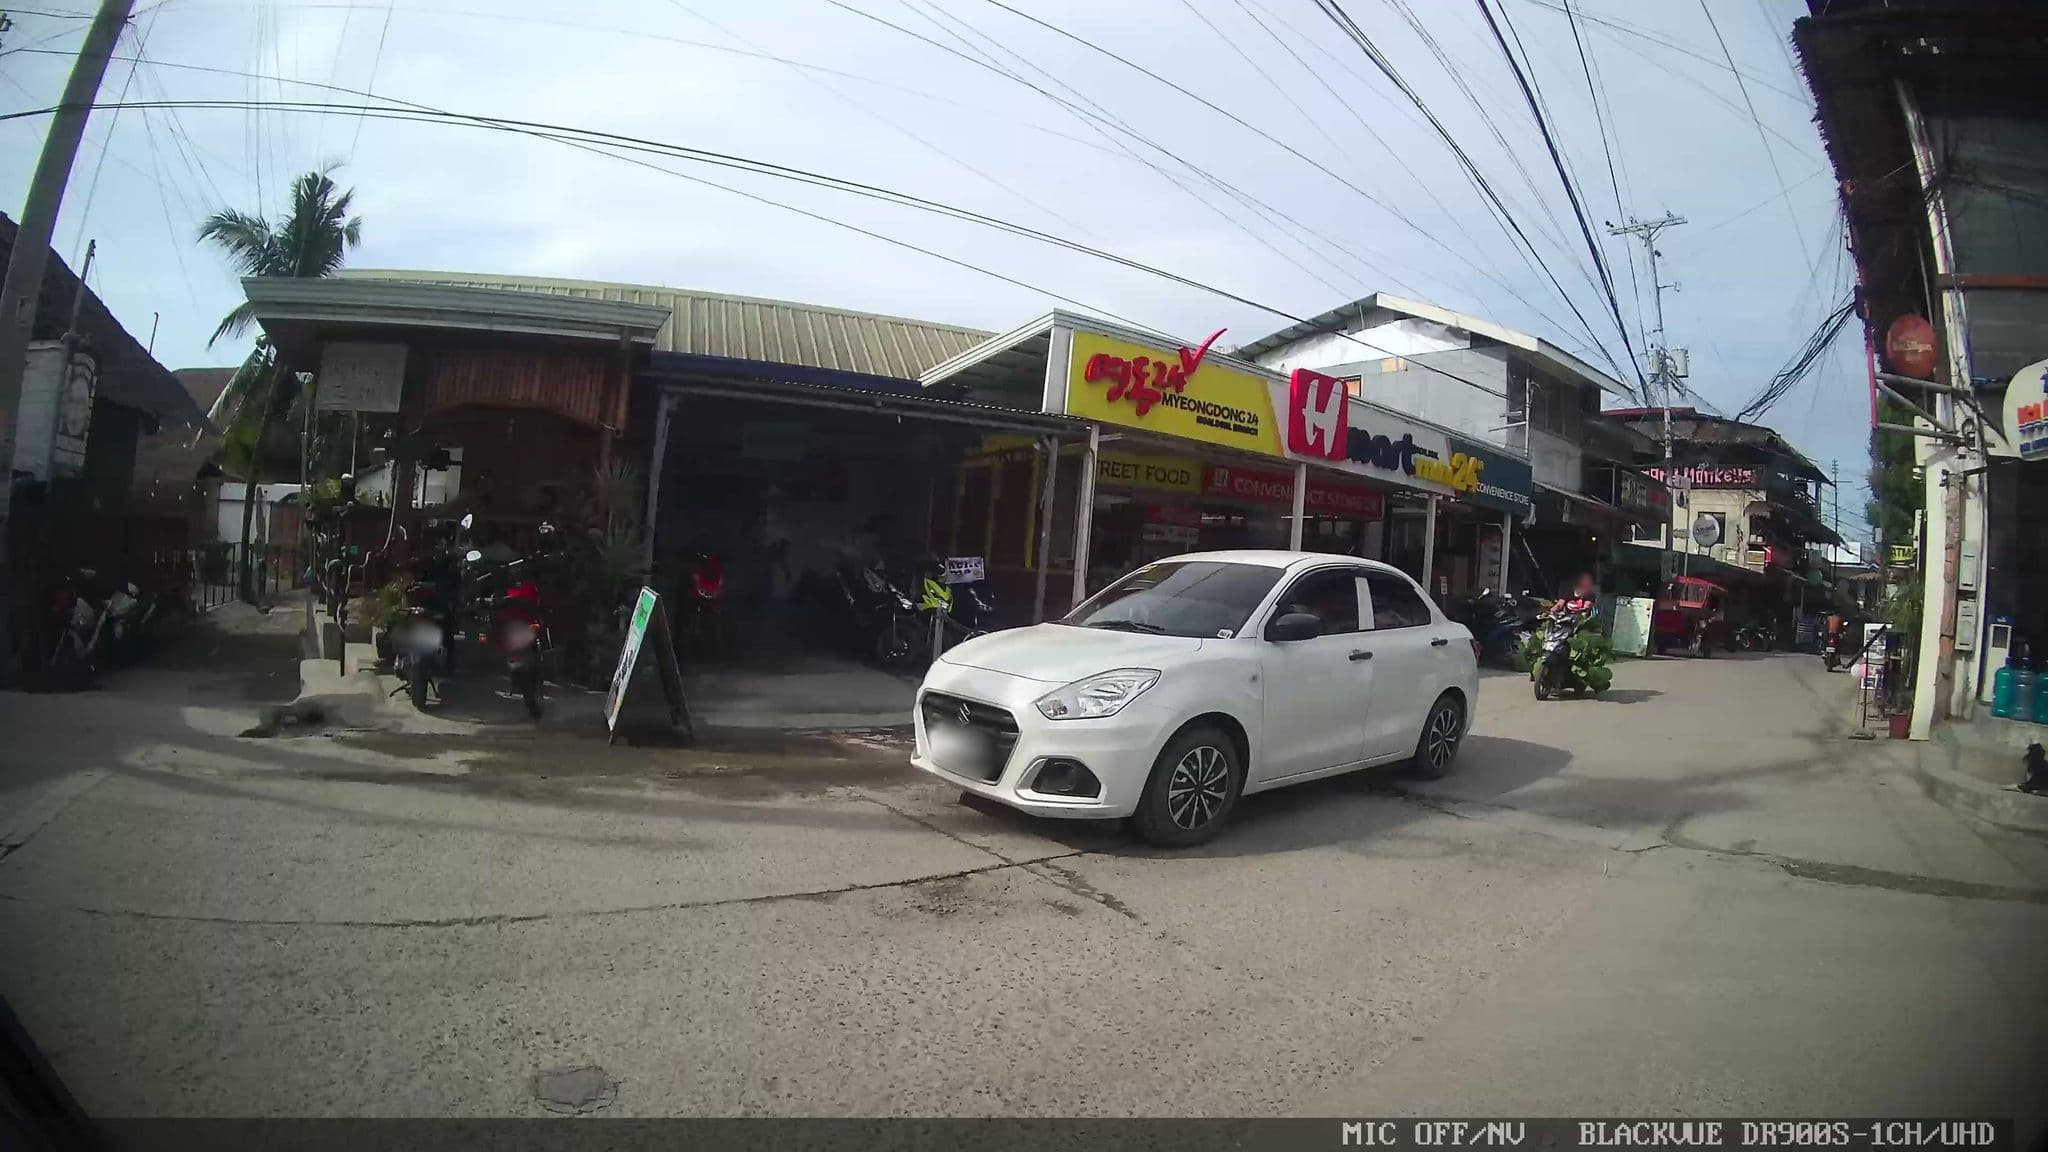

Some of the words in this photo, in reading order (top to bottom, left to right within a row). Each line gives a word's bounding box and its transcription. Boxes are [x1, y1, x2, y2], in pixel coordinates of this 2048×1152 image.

[1161, 391, 1245, 423] MYEONGDONG
[1246, 412, 1259, 426] 24
[1097, 458, 1141, 481] REET
[1145, 464, 1190, 485] FOOD
